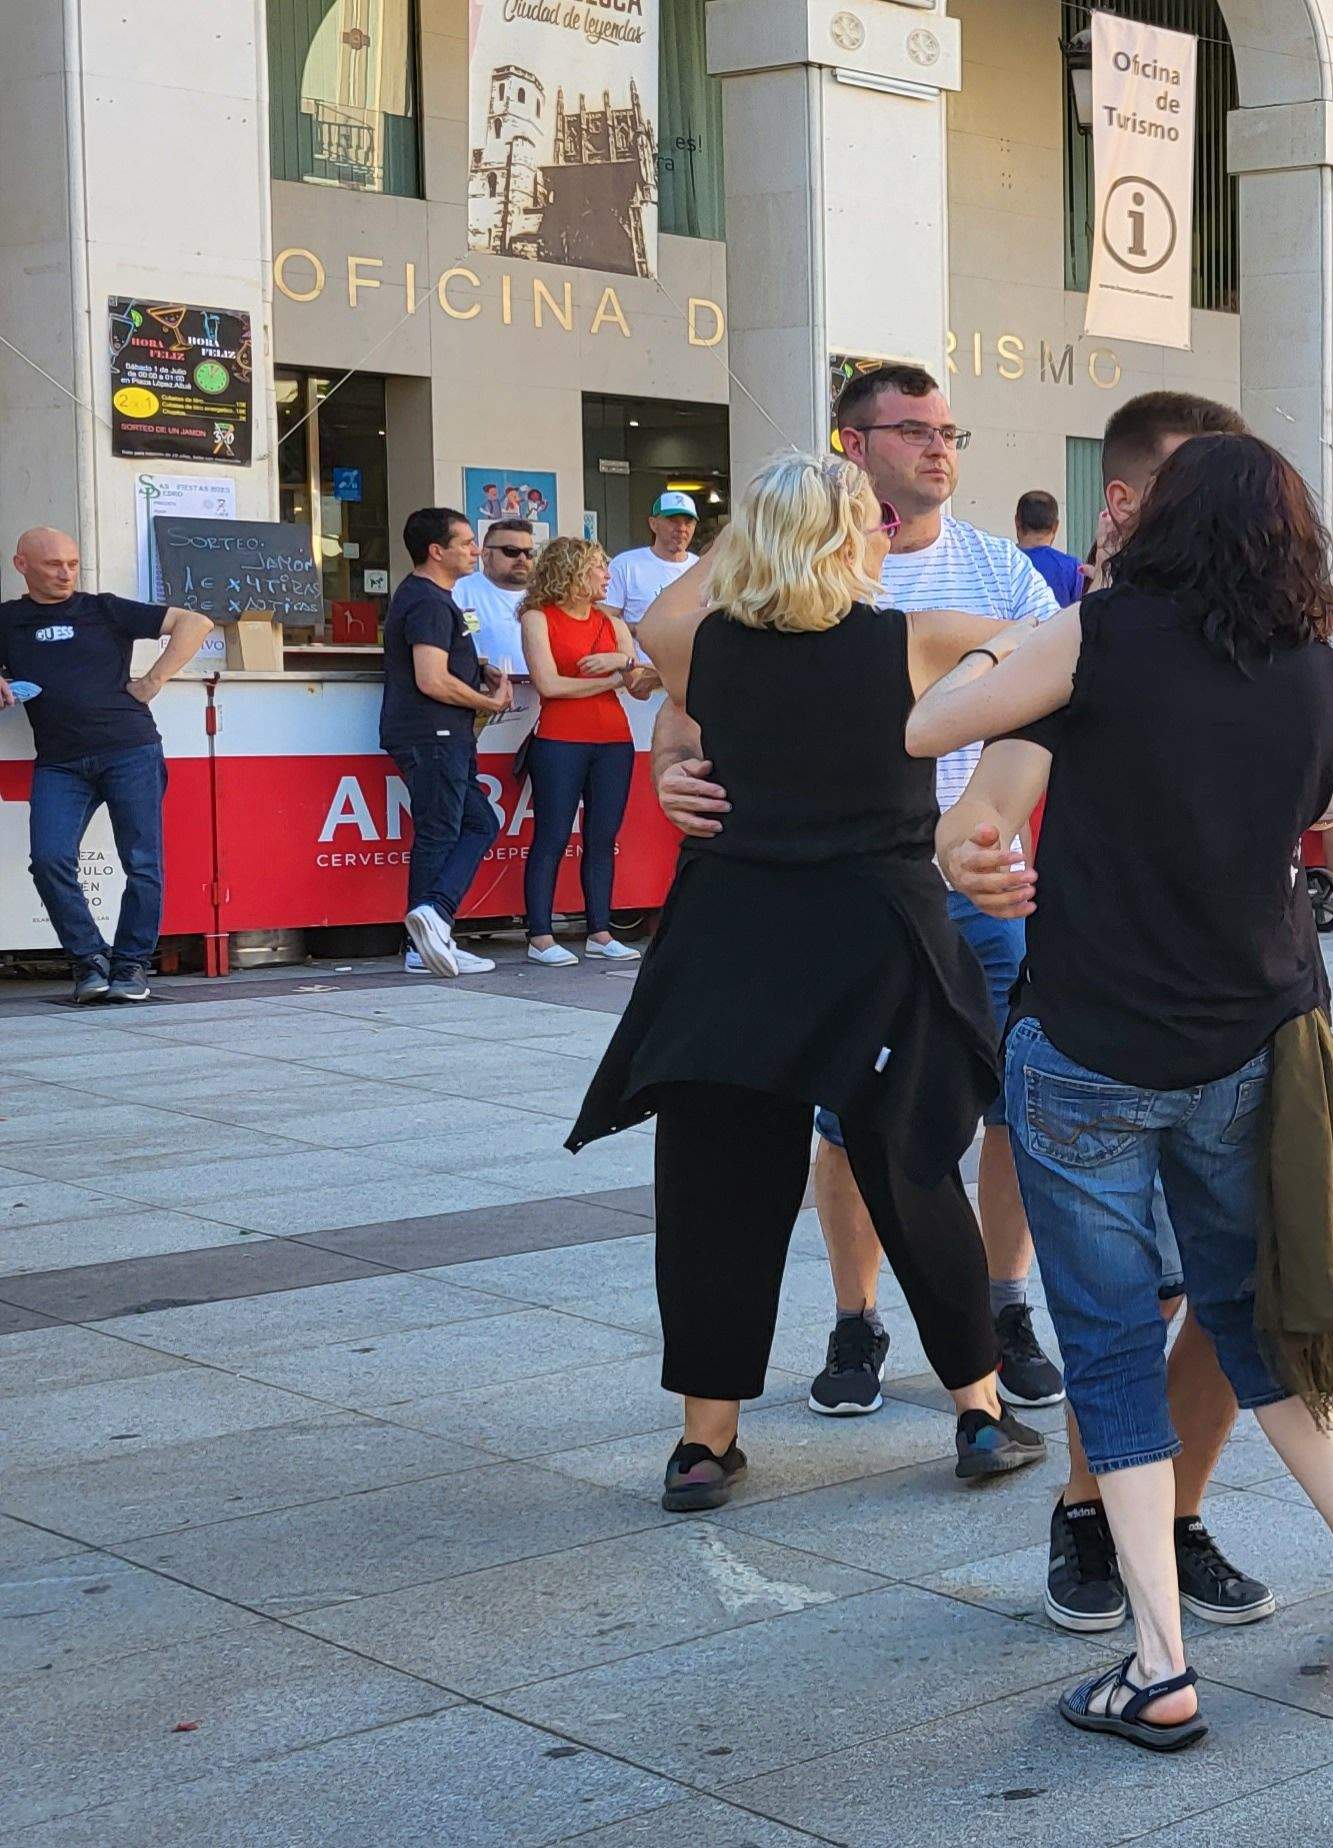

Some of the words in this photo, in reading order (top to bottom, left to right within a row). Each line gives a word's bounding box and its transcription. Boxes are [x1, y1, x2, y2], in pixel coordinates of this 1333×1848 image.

[563, 5, 580, 30] de
[584, 8, 646, 46] leyendas
[1113, 51, 1181, 85] Oficina
[1155, 91, 1181, 114] de
[1103, 105, 1180, 142] Turismo
[273, 247, 631, 338] OFICINA
[687, 297, 726, 347] D
[131, 336, 164, 349] HORA
[149, 348, 185, 361] FELIZ
[201, 347, 237, 360] FELIZ
[946, 330, 1121, 390] RISMO
[35, 625, 75, 641] GUESS
[79, 851, 105, 861] EZA
[316, 851, 412, 868] CERVECE
